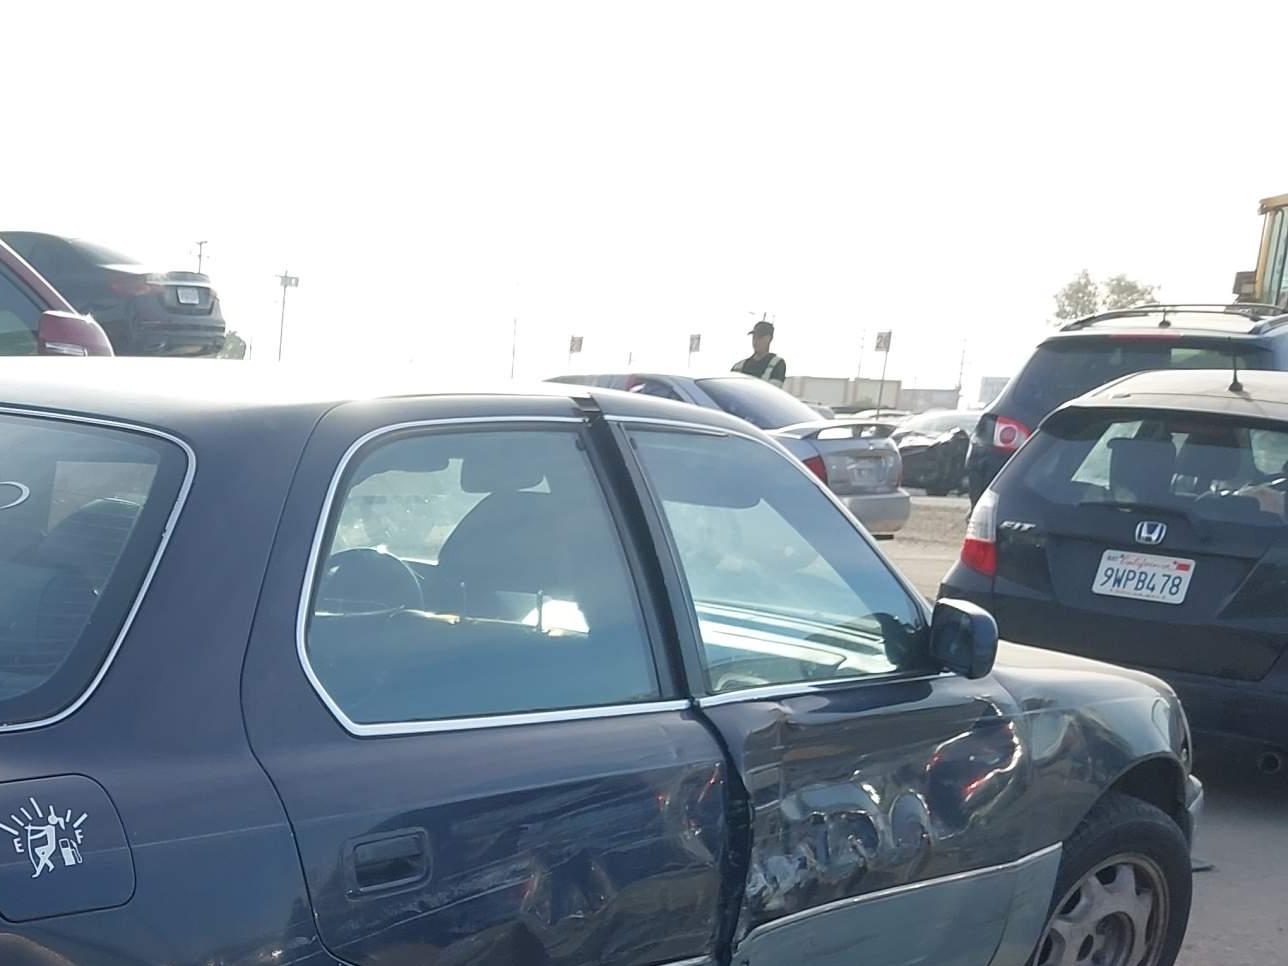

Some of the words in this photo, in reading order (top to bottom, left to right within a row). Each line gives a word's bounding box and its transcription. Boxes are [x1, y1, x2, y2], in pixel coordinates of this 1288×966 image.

[999, 520, 1037, 532] FIT
[1099, 566, 1183, 596] 9WPB478
[13, 837, 25, 853] E
